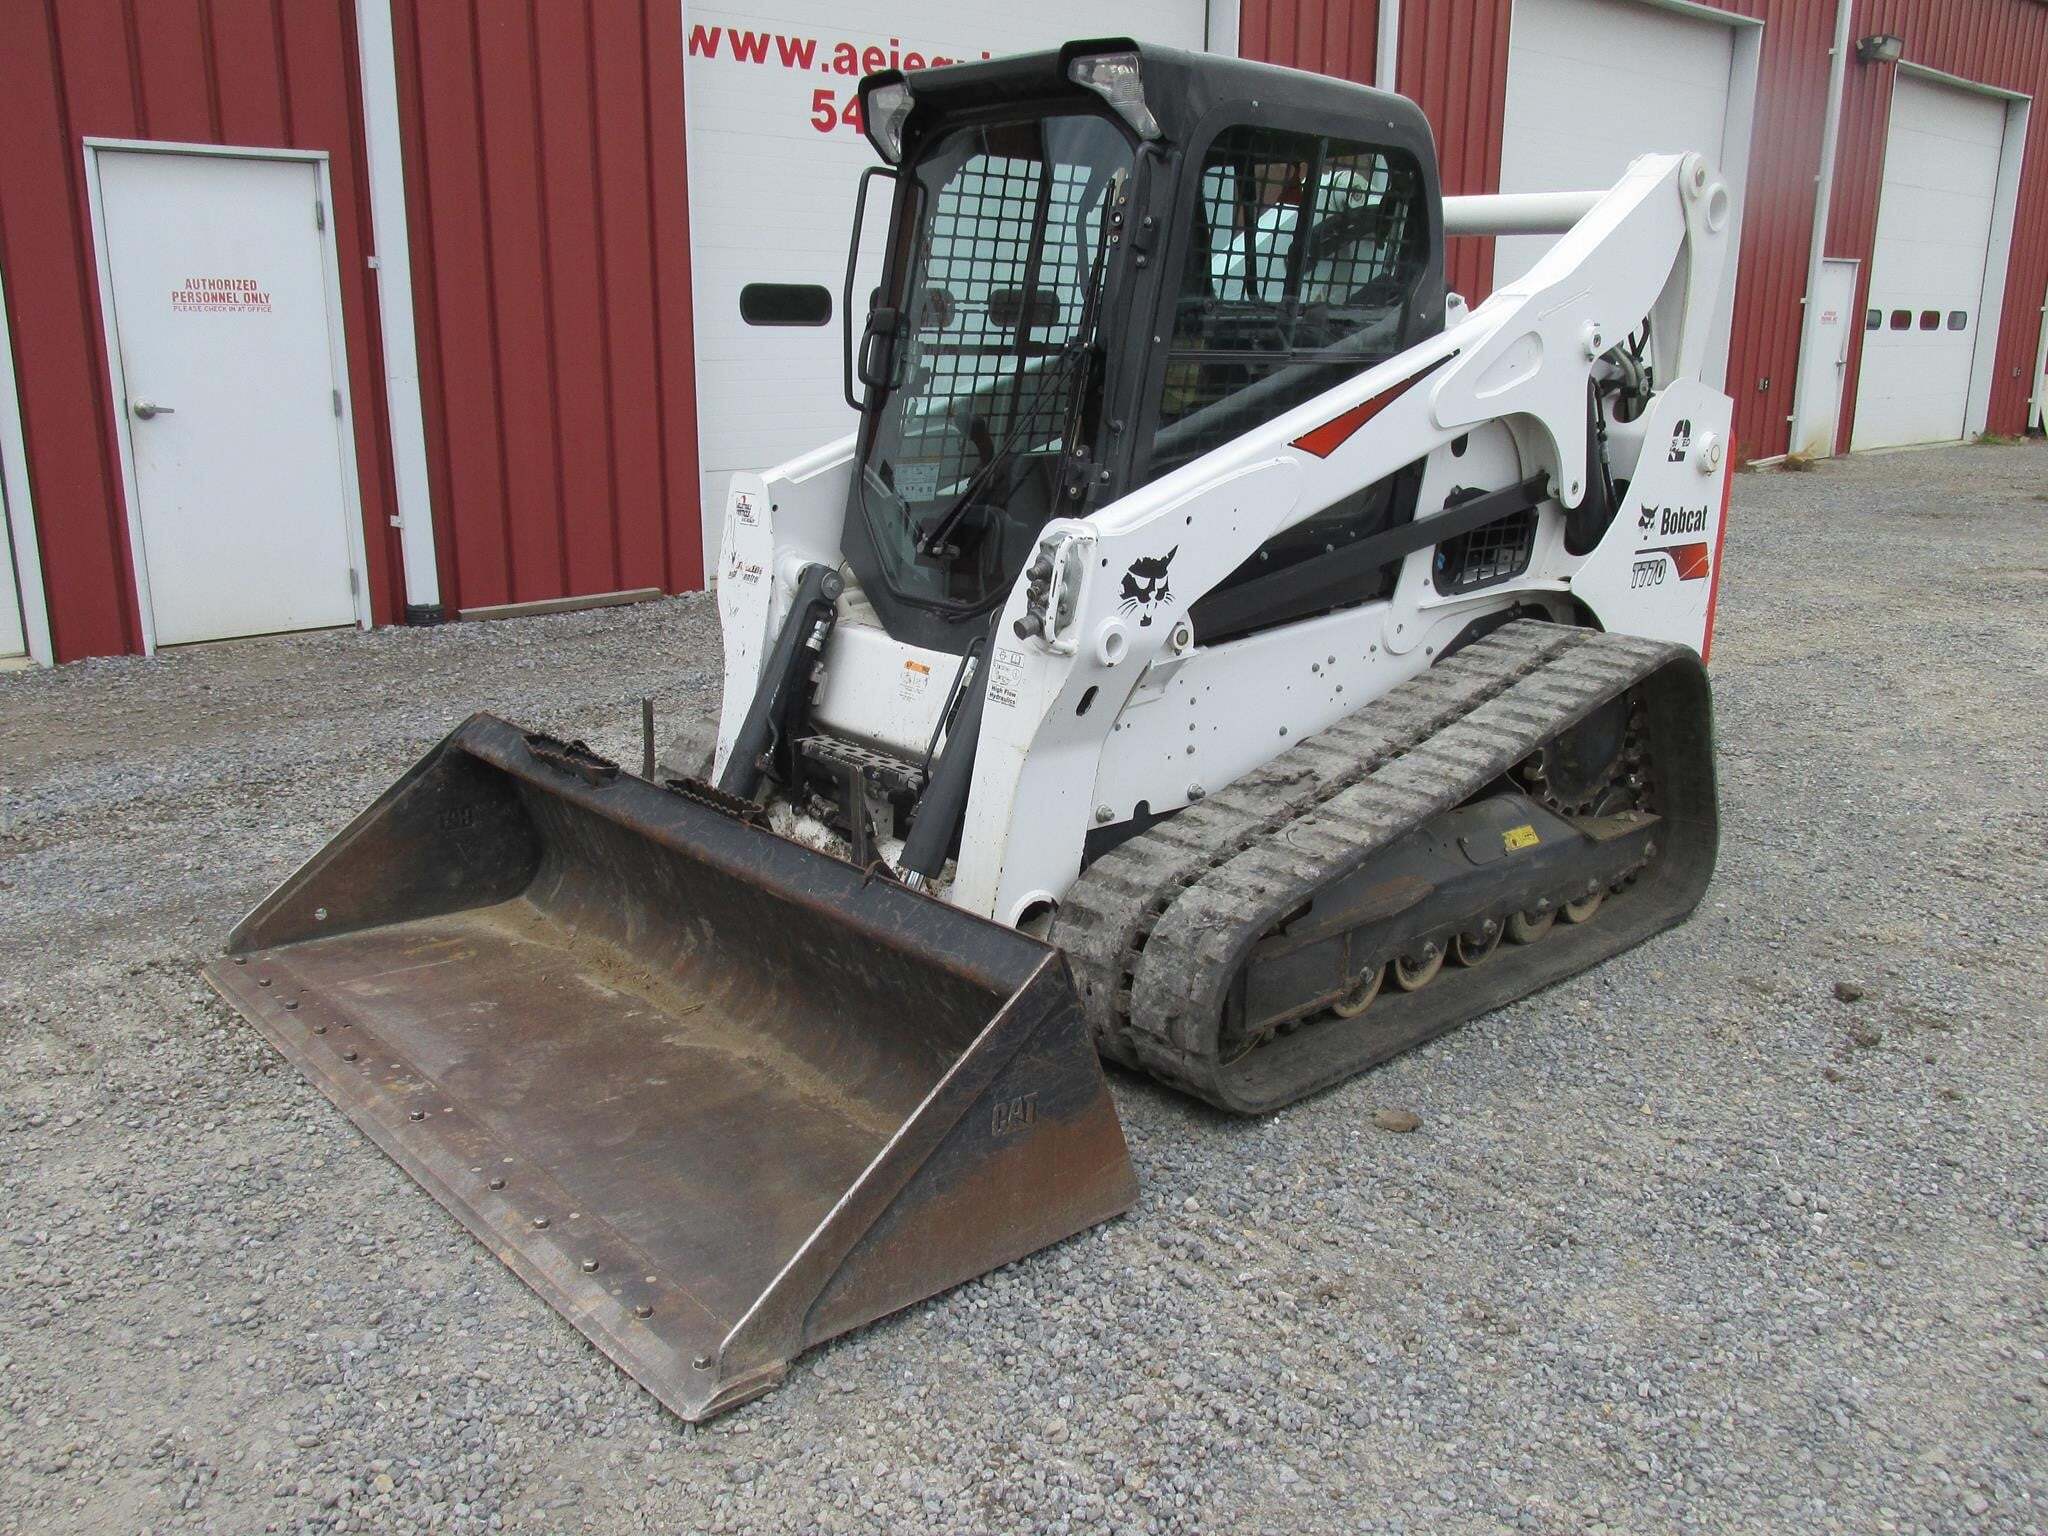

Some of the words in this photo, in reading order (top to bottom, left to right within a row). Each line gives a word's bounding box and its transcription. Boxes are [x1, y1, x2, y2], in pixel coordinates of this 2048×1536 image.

[185, 278, 258, 291] AUTHORIZED
[171, 291, 240, 304] PERSONNEL
[243, 293, 271, 305] ONLY
[173, 305, 202, 313] PLEASE
[247, 306, 273, 314] OFFICE
[1660, 504, 1708, 536] Bobcat
[1631, 558, 1667, 589] T770
[991, 1091, 1040, 1137] CAT
